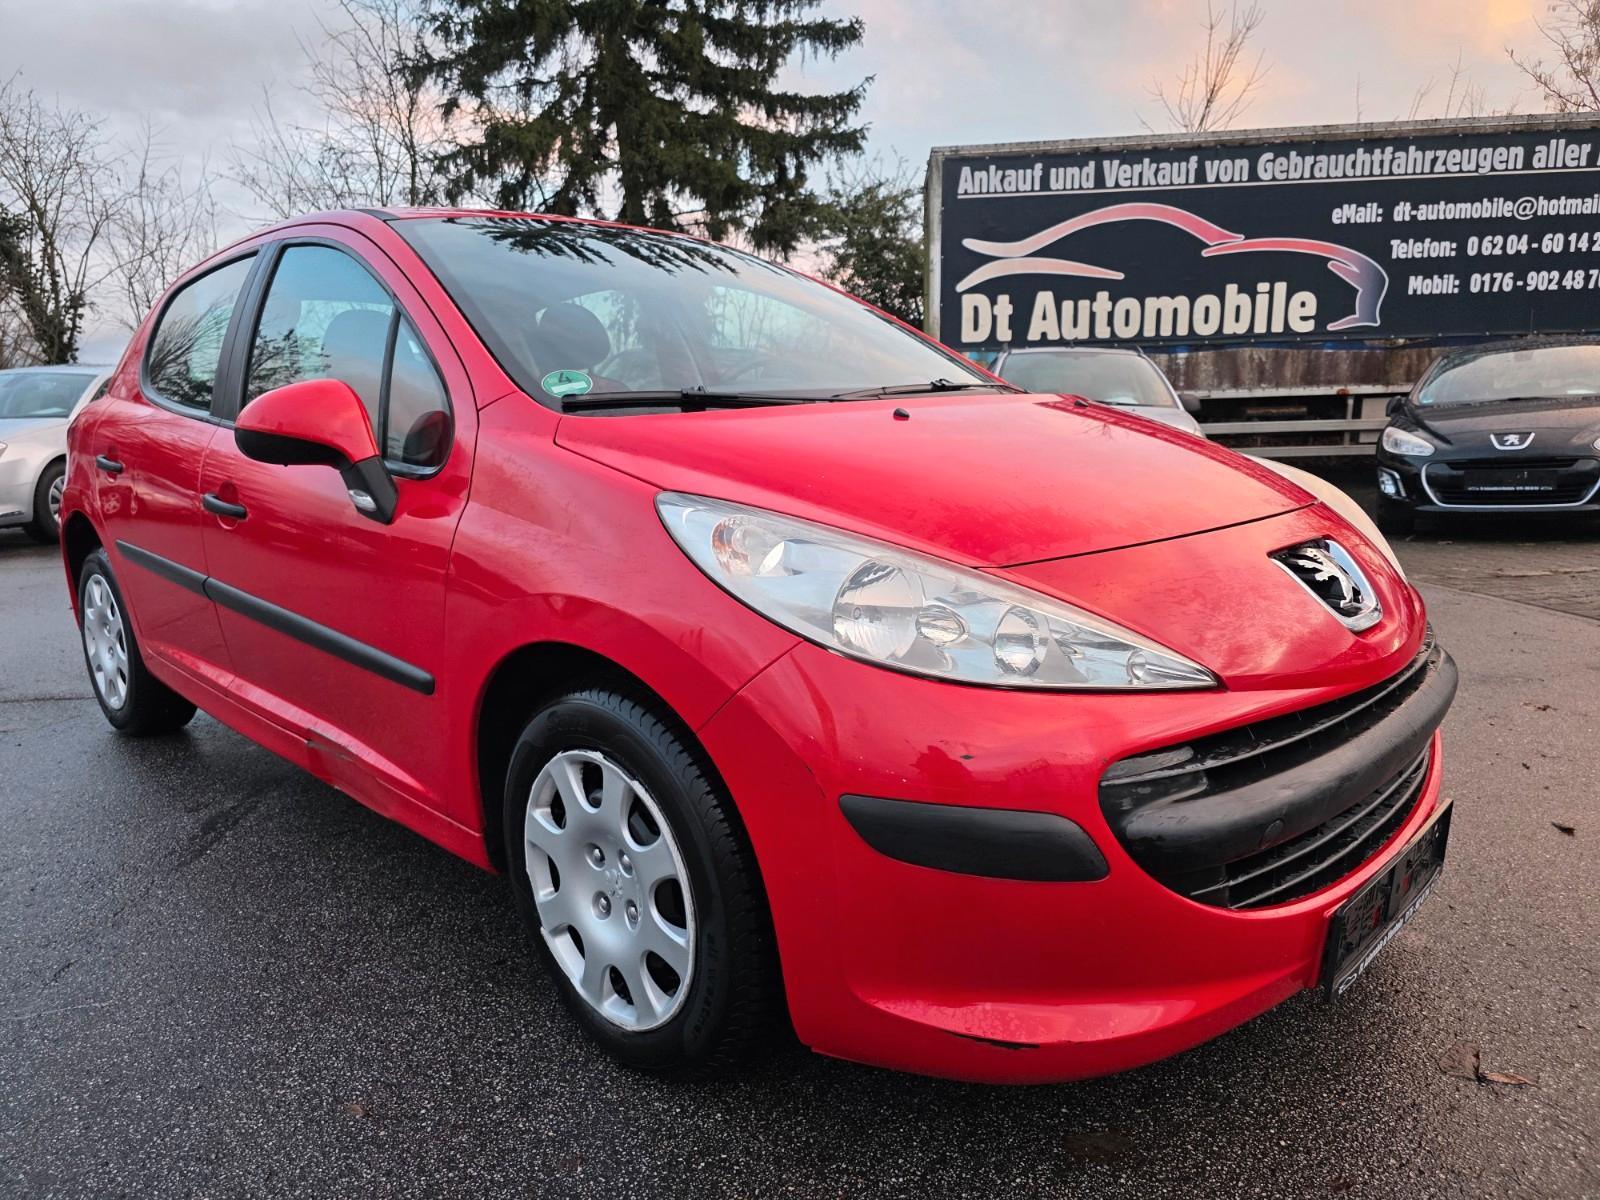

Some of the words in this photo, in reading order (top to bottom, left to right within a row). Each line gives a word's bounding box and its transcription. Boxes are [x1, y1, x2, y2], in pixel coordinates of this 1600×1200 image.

[958, 163, 1042, 195] Ankauf
[1050, 161, 1095, 191] und
[1103, 156, 1197, 188] Verkauf
[1205, 159, 1249, 183] von
[1257, 146, 1524, 180] Gebrauchtfahrzeugen
[1532, 139, 1591, 168] aller
[1332, 203, 1383, 225] eMail:
[1391, 237, 1456, 258] Telefon:
[1408, 274, 1459, 294] Mobil:
[1470, 272, 1514, 293] 0176
[1527, 271, 1559, 291] 902
[1562, 270, 1584, 290] 48
[961, 294, 1013, 344] Dt
[1027, 282, 1317, 340] Automobile
